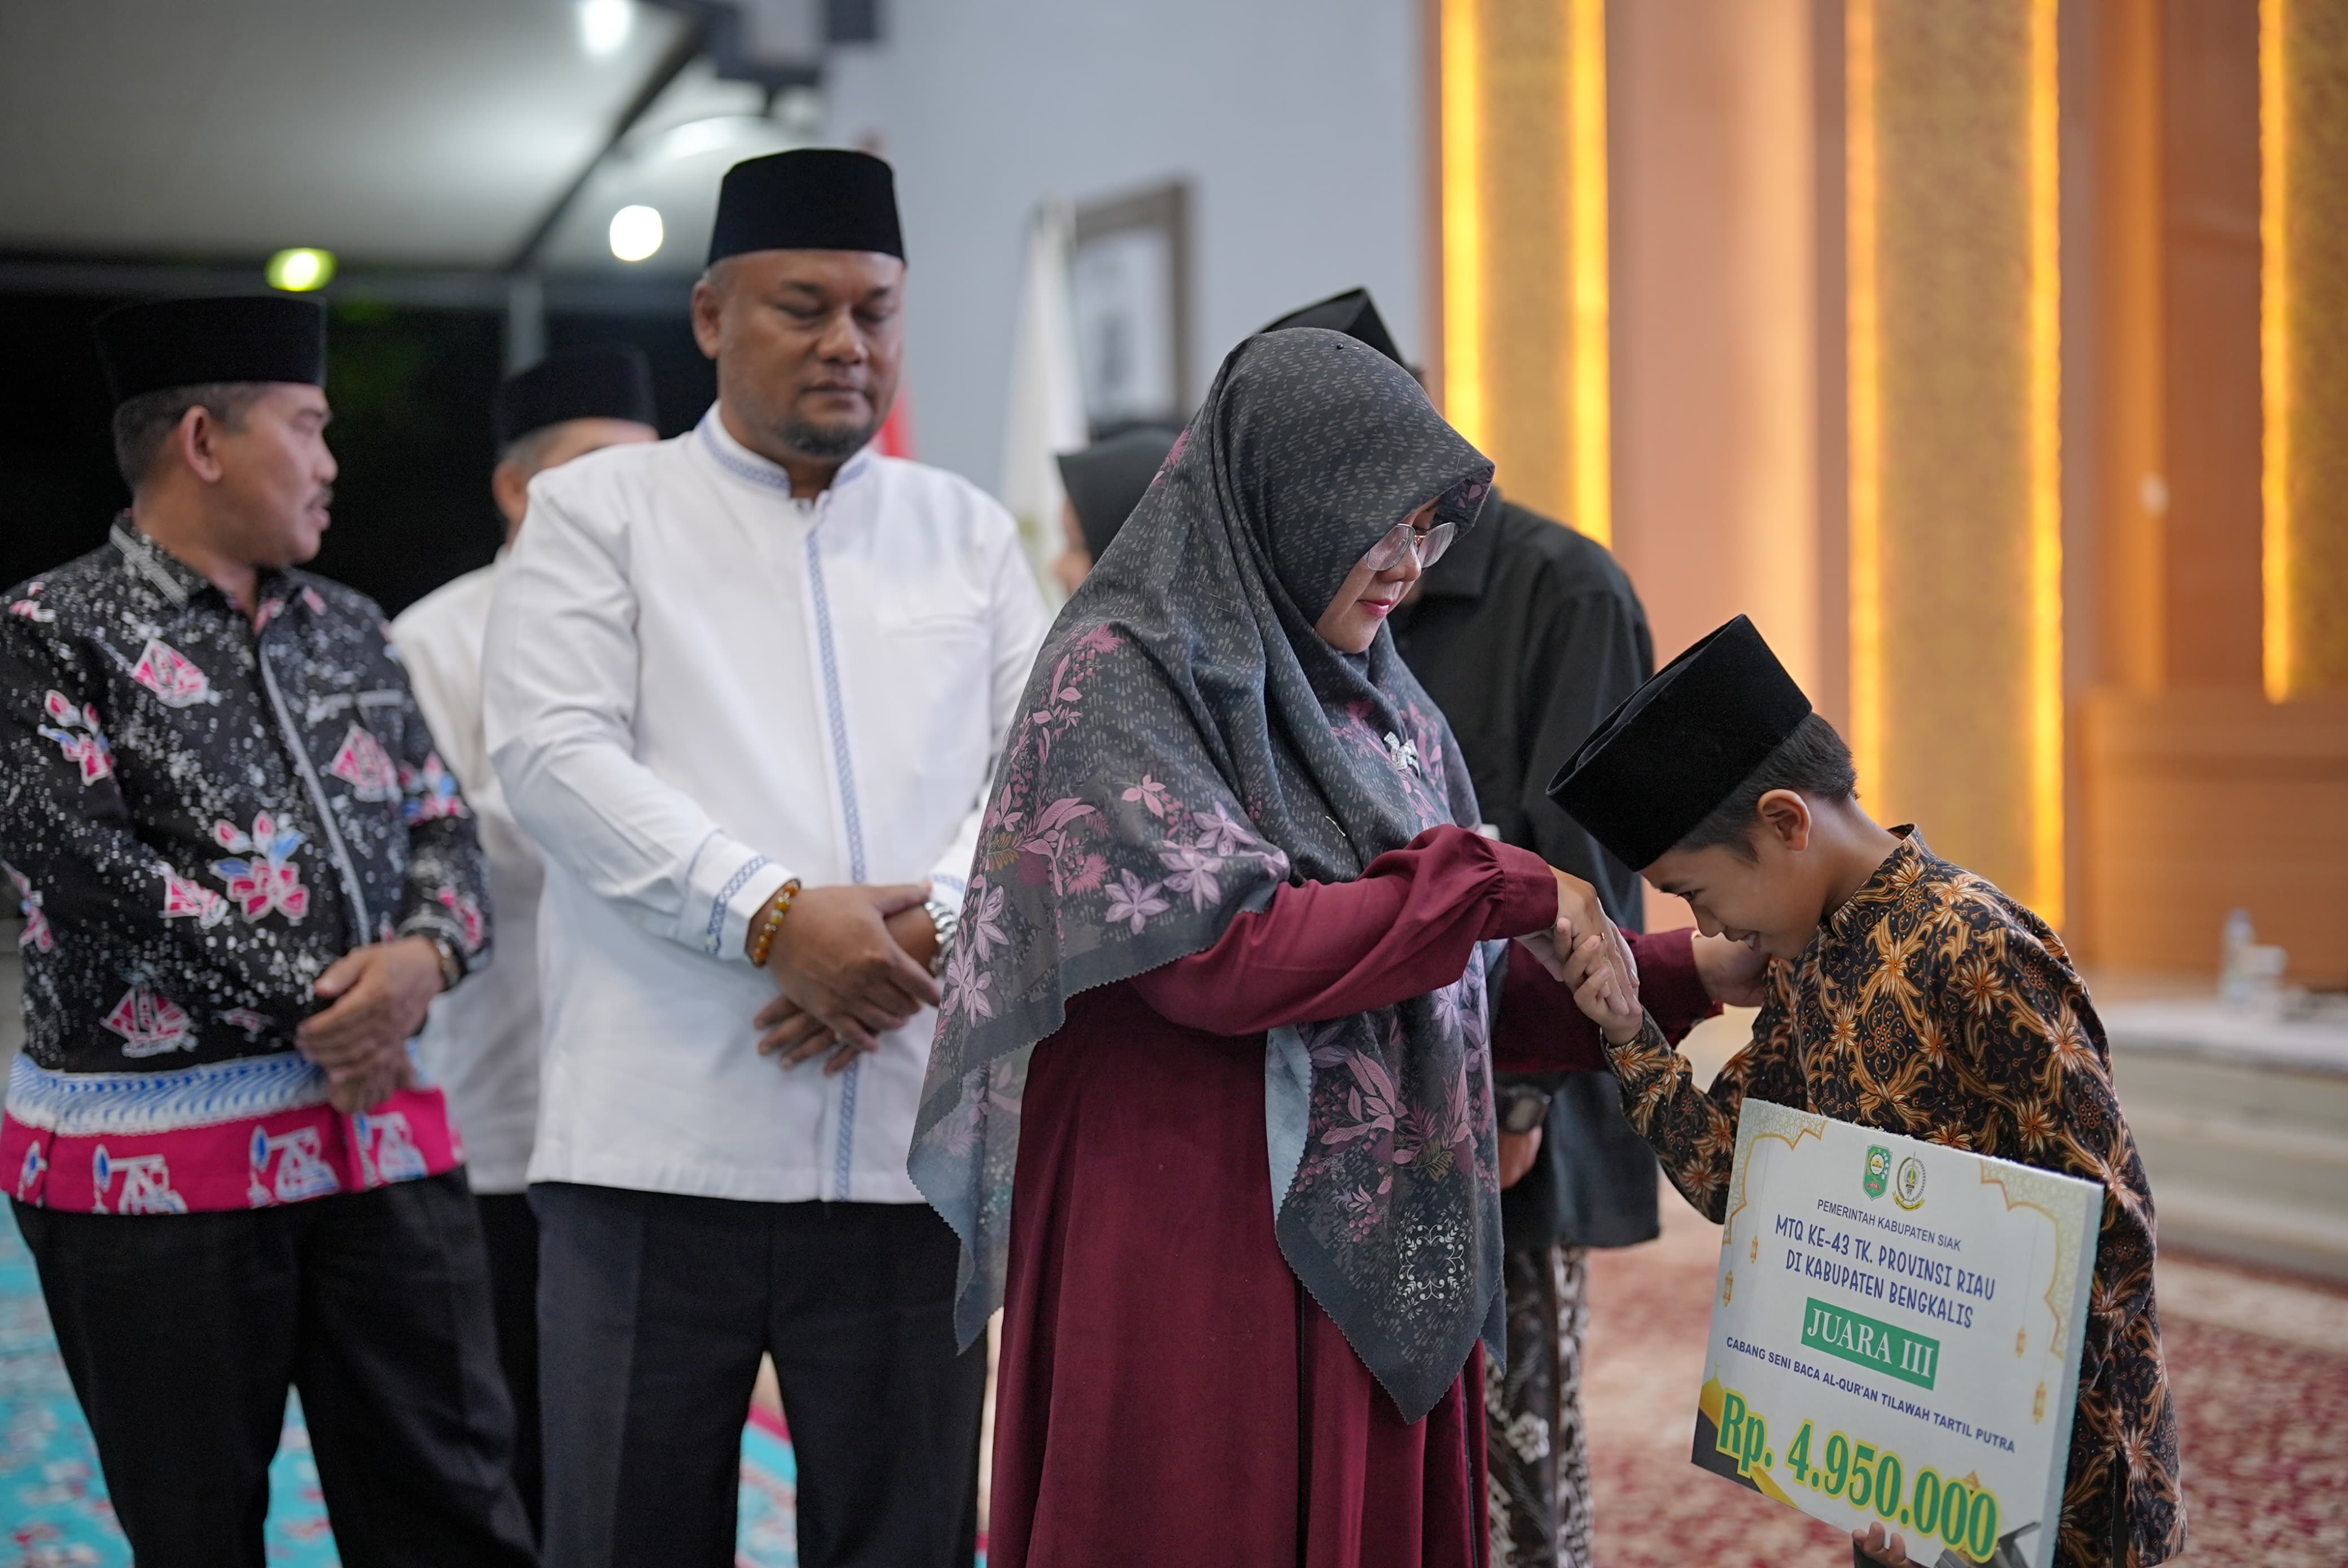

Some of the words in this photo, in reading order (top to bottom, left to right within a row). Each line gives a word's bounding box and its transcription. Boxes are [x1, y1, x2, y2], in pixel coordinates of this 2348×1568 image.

[1775, 1214, 1804, 1241] MTQ
[1808, 1224, 1850, 1255] KE-43
[1855, 1239, 1873, 1263] TK.
[1878, 1245, 1953, 1287] PROVINSI
[1957, 1269, 1996, 1300] RIAU
[1817, 1199, 1876, 1226] PEMERINTAH
[1877, 1217, 1935, 1243] KABUPATEN
[1937, 1234, 1962, 1251] SIAK
[1786, 1249, 1803, 1272] DI
[1805, 1255, 1884, 1299] KABUPATEN
[1889, 1282, 1974, 1328] BENGKALIS
[1807, 1308, 1893, 1364] JUARA
[1899, 1339, 1935, 1378] III
[1727, 1337, 1766, 1360] CABANG
[1768, 1352, 1791, 1369] SENI
[1793, 1361, 1820, 1380] BACA
[1823, 1373, 1878, 1402] AL-QUR'AN
[1881, 1393, 1930, 1421] TILAWAH
[1933, 1412, 1972, 1437] TARTIL
[1975, 1428, 2016, 1453] PUTRA
[1718, 1391, 1773, 1474] Rp.
[1786, 1422, 1998, 1558] 4.950.000
